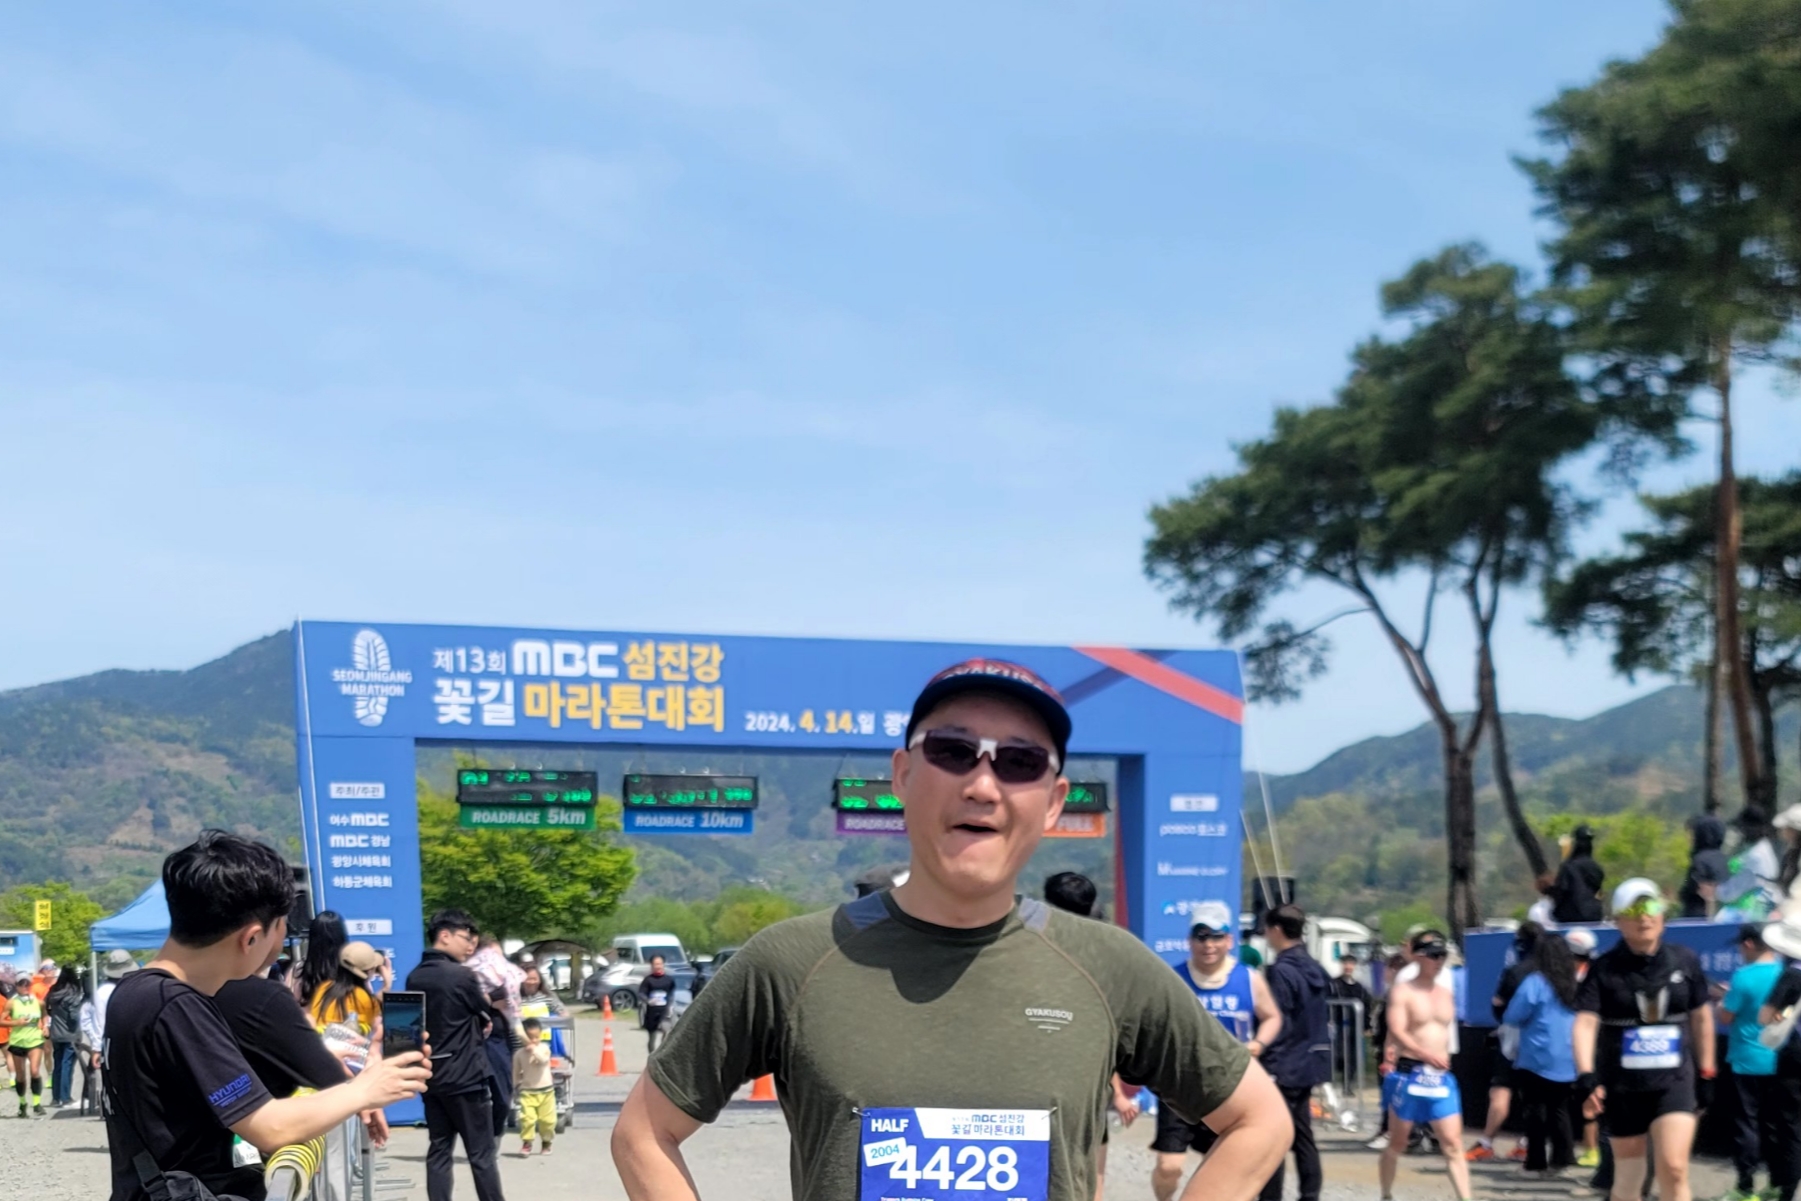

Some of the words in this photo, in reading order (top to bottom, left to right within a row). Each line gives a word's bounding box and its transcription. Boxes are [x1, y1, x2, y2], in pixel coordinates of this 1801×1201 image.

[433, 647, 507, 676] 제13회
[624, 641, 724, 681] 섬진강
[341, 684, 406, 697] MARATHON
[433, 678, 516, 726] 꽃길
[523, 682, 725, 732] 마라톤대회
[745, 712, 796, 733] 2024.
[799, 709, 821, 734] 4.
[472, 810, 540, 824] ROADRACE
[546, 807, 586, 825] 5km
[634, 814, 696, 827] ROADRACE
[699, 811, 745, 828] 10km
[1025, 1007, 1073, 1021] GYAKUSOU
[208, 1073, 251, 1103] HYUNDAI
[871, 1118, 909, 1133] HALF
[999, 1114, 1025, 1124] 섬진강
[951, 1124, 972, 1135] 꽃길
[973, 1124, 1026, 1136] 마라톤대회
[870, 1143, 900, 1159] 2004
[889, 1145, 1019, 1191] 4428
